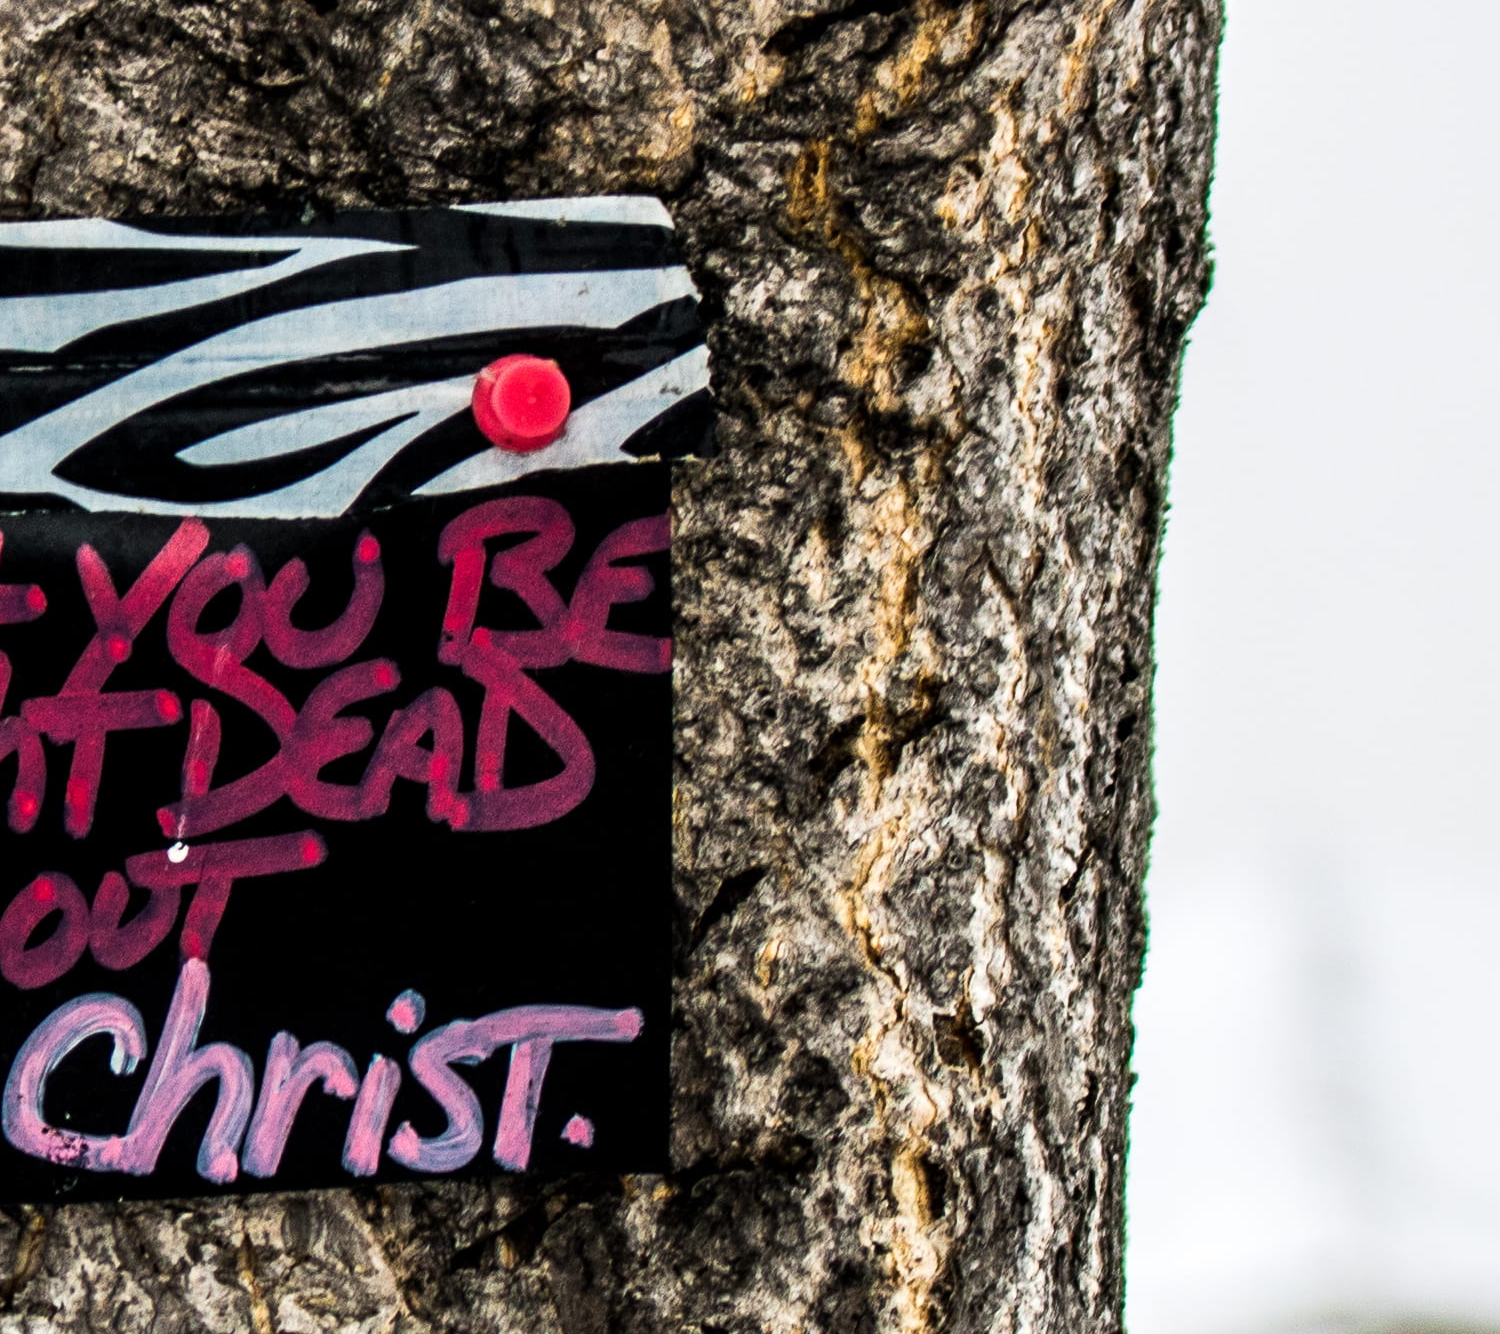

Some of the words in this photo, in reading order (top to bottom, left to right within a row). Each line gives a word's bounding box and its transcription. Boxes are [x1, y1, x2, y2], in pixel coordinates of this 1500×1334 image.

[50, 517, 385, 742] YOU
[437, 495, 672, 673] BE
[156, 637, 597, 833] DEAD
